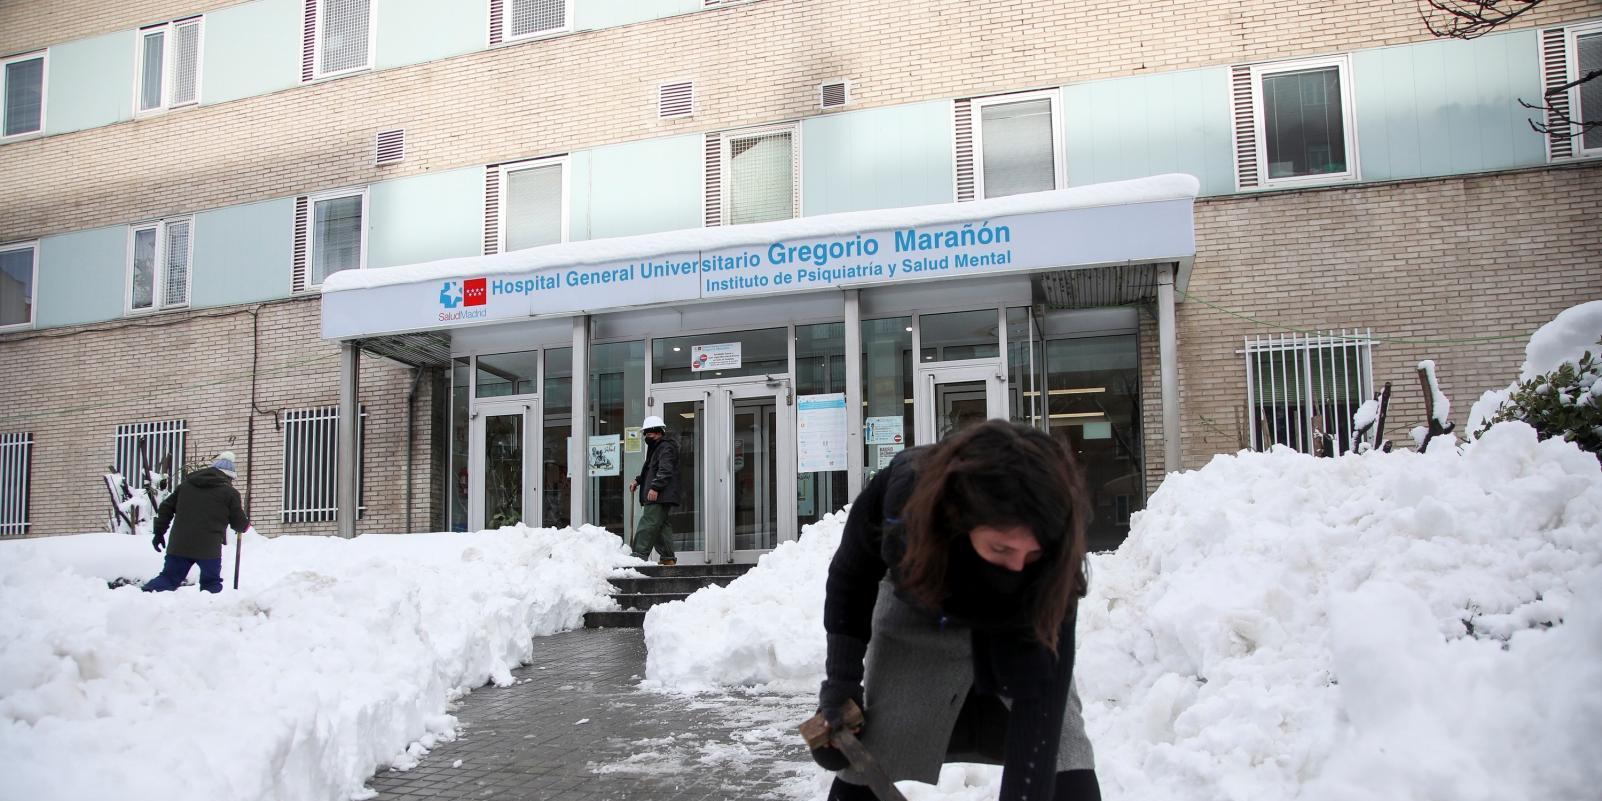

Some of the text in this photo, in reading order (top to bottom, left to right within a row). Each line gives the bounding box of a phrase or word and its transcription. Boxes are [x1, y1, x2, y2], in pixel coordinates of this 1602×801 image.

[492, 220, 1010, 295] Hospital General Universitario Gregorio Marañón
[706, 250, 1012, 292] Instituto de Psiquiatría y Salud Mental
[438, 308, 487, 322] SaludMadrid
